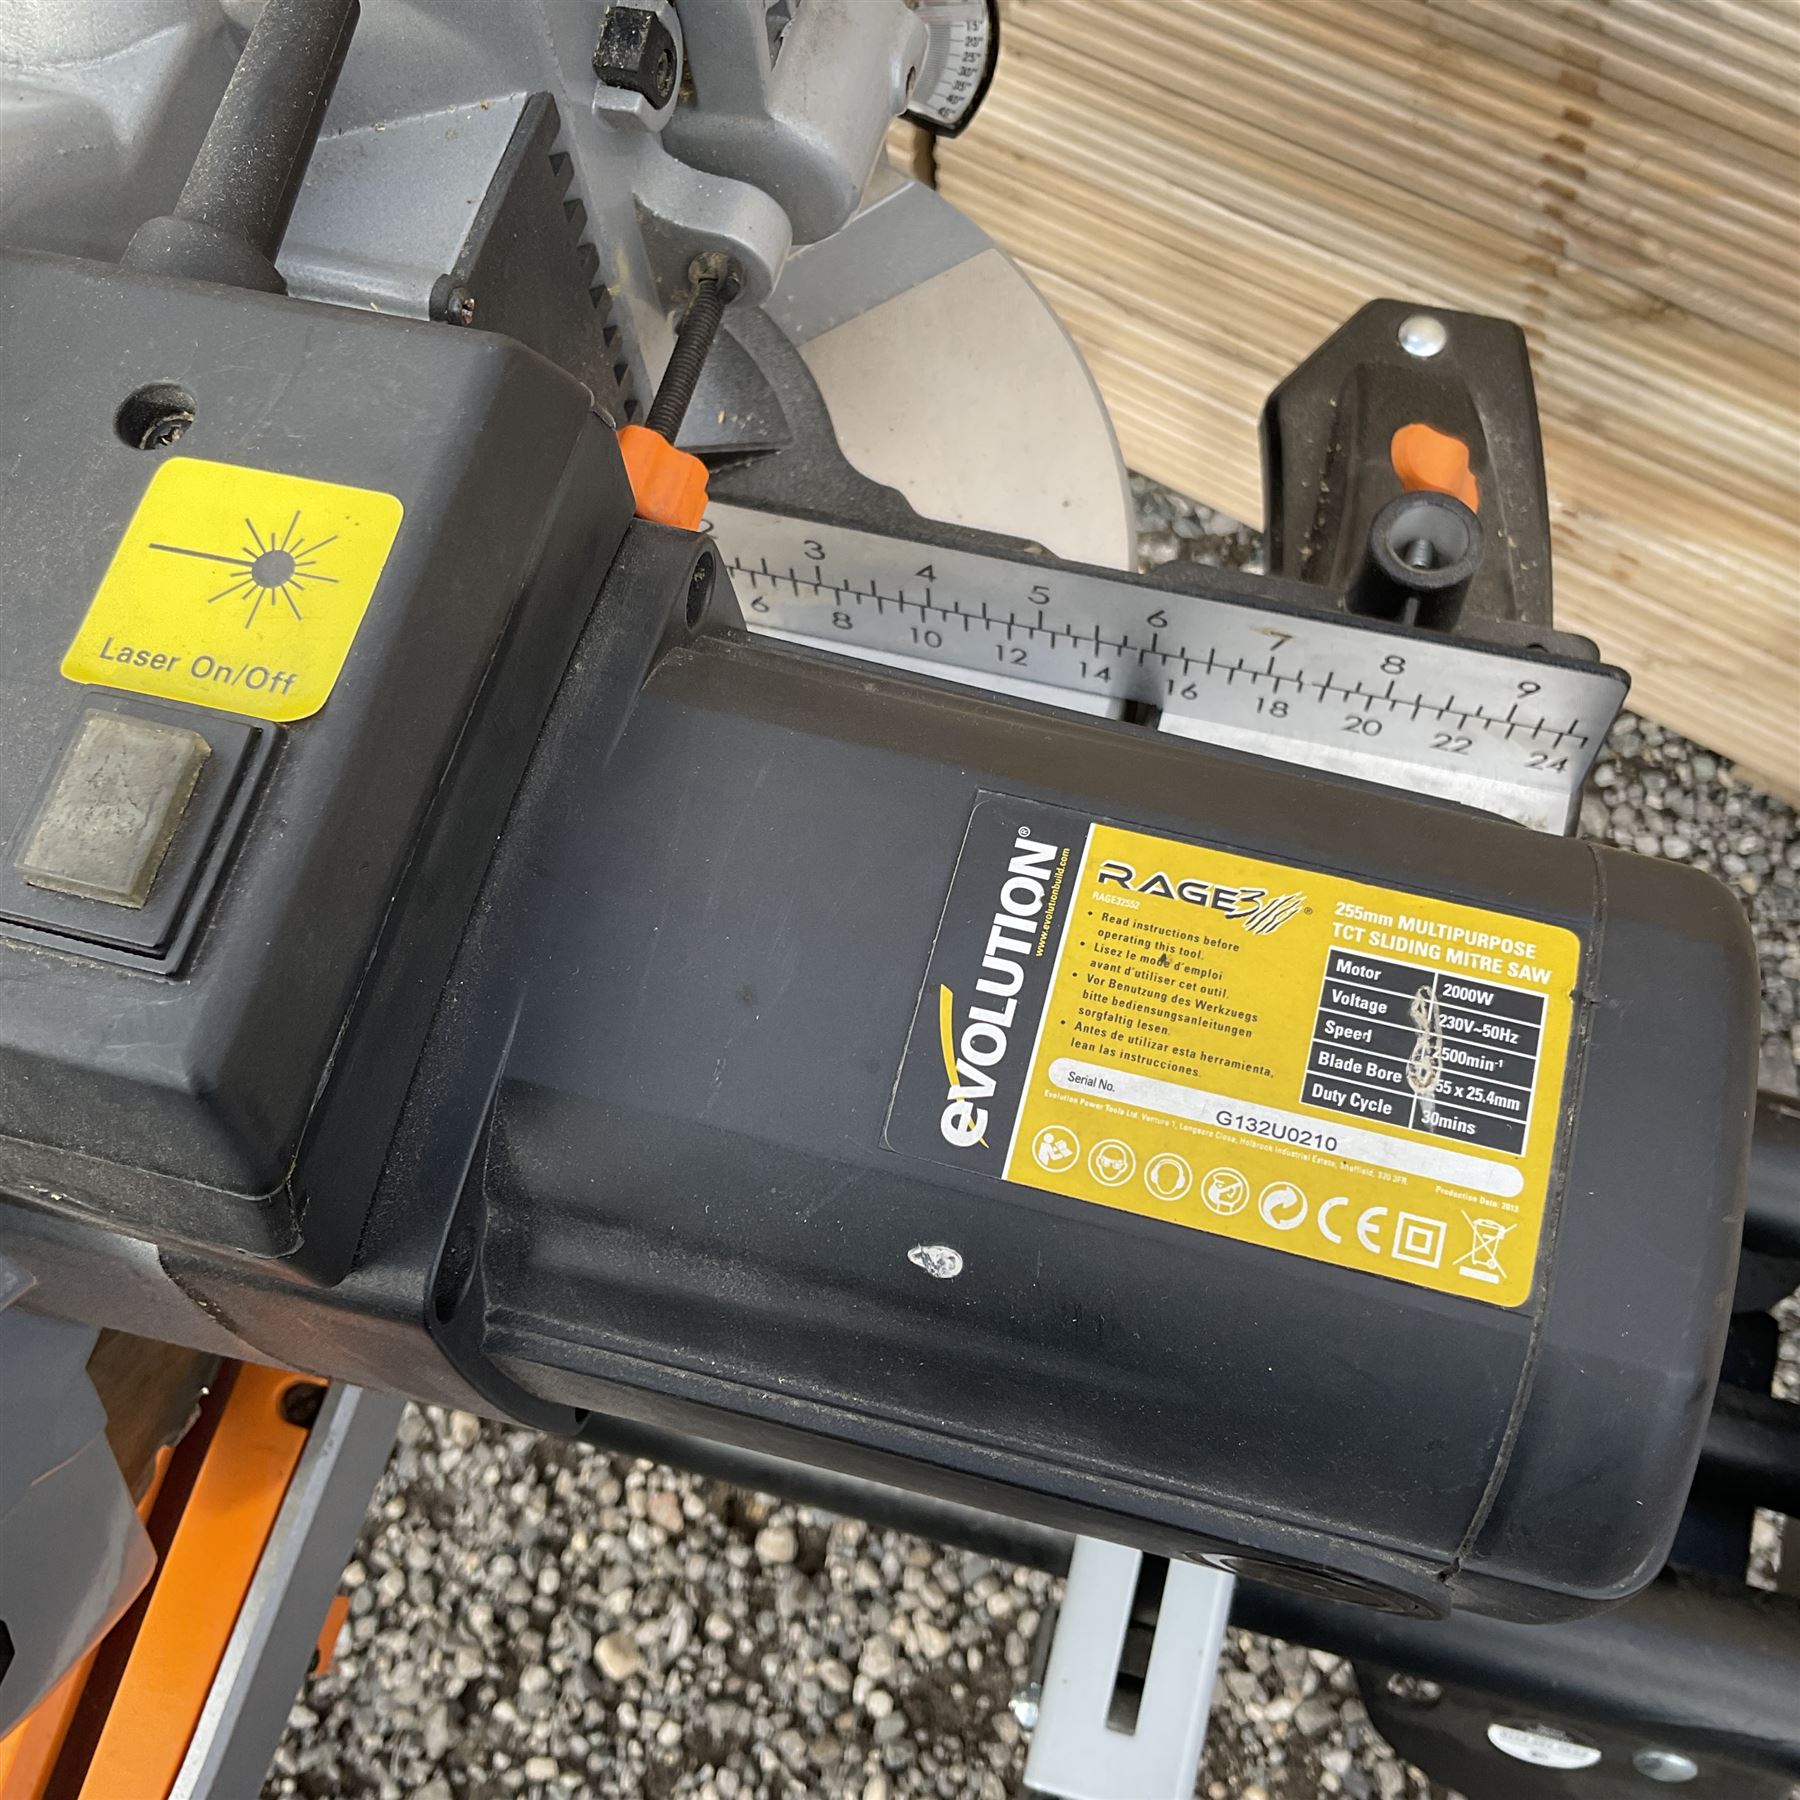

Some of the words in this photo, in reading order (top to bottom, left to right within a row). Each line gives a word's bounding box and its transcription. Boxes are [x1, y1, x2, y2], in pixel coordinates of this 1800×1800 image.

[804, 540, 825, 560] 3
[915, 564, 937, 583] 4
[1027, 585, 1050, 605] 5
[1147, 609, 1168, 629] 6
[1268, 631, 1293, 650] 7
[1380, 655, 1406, 675] 8
[1517, 681, 1542, 699] 9
[99, 637, 181, 672] Laser
[191, 655, 298, 695] On/Off
[751, 596, 770, 613] 6
[832, 612, 853, 630] 8
[910, 627, 943, 648] 10
[996, 645, 1028, 667] 12
[1079, 661, 1112, 683] 14
[1167, 679, 1198, 701] 16
[1255, 698, 1290, 718] 18
[1341, 716, 1382, 736] 20
[1430, 733, 1473, 755] 22
[1524, 751, 1568, 774] 24
[1036, 847, 1070, 957] www.evolutionbuild.com
[1097, 929, 1150, 949] operating
[1154, 941, 1175, 953] this
[1179, 946, 1203, 958] tool.
[1101, 912, 1129, 926] Read
[1132, 921, 1199, 942] instructions
[1203, 935, 1239, 951] before
[1335, 901, 1393, 926] 255mm
[1397, 915, 1535, 958] MULTIPURPOSE
[1093, 942, 1122, 957] Lisez
[1125, 949, 1136, 960] le
[1139, 955, 1170, 969] mode
[1333, 922, 1365, 941] TCT
[1368, 931, 1440, 959] SLIDING
[1445, 947, 1502, 973] MITRE
[1507, 961, 1551, 984] SAW
[1087, 973, 1105, 985] Vor
[1108, 978, 1167, 1003] Benutzung
[1170, 994, 1190, 1006] des
[1195, 998, 1257, 1022] Werkzuegs
[1089, 960, 1121, 973] avant
[1124, 966, 1175, 985] d'utiliser
[1178, 981, 1196, 991] cet
[1199, 986, 1228, 997] outil.
[1335, 958, 1381, 980] Motor
[1442, 983, 1494, 1005] 2000W
[1078, 1007, 1133, 1028] sorgfaltig
[1136, 1018, 1170, 1034] lesen.
[1082, 989, 1108, 1003] bitte
[1111, 995, 1251, 1037] bediensungsanleitungen
[1332, 988, 1387, 1014] Voltage
[1074, 1021, 1106, 1037] Antes
[1110, 1030, 1124, 1041] de
[1127, 1036, 1168, 1051] utilizar
[1172, 1046, 1196, 1058] esta
[1199, 1050, 1273, 1078] herramienta,
[1324, 1019, 1372, 1042] Speed
[1070, 1036, 1094, 1051] lean
[1098, 1044, 1115, 1056] las
[1119, 1051, 1201, 1076] instrucciones.
[1044, 1089, 1078, 1102] Evolution
[1079, 1098, 1102, 1108] Power
[1105, 1104, 1124, 1114] Tools
[1067, 1071, 1097, 1087] Serial
[1098, 1078, 1115, 1092] No.
[1318, 1050, 1362, 1073] Blade
[1365, 1062, 1402, 1082] Bore
[1453, 1086, 1463, 1097] x
[1465, 1085, 1520, 1110] 25.4mm
[1311, 1082, 1346, 1106] Duty
[1349, 1092, 1392, 1114] Cycle
[1421, 1107, 1475, 1134] 30mins
[1216, 1110, 1337, 1151] G132U0210
[1435, 1185, 1477, 1201] Production
[1502, 1202, 1518, 1212] 2013
